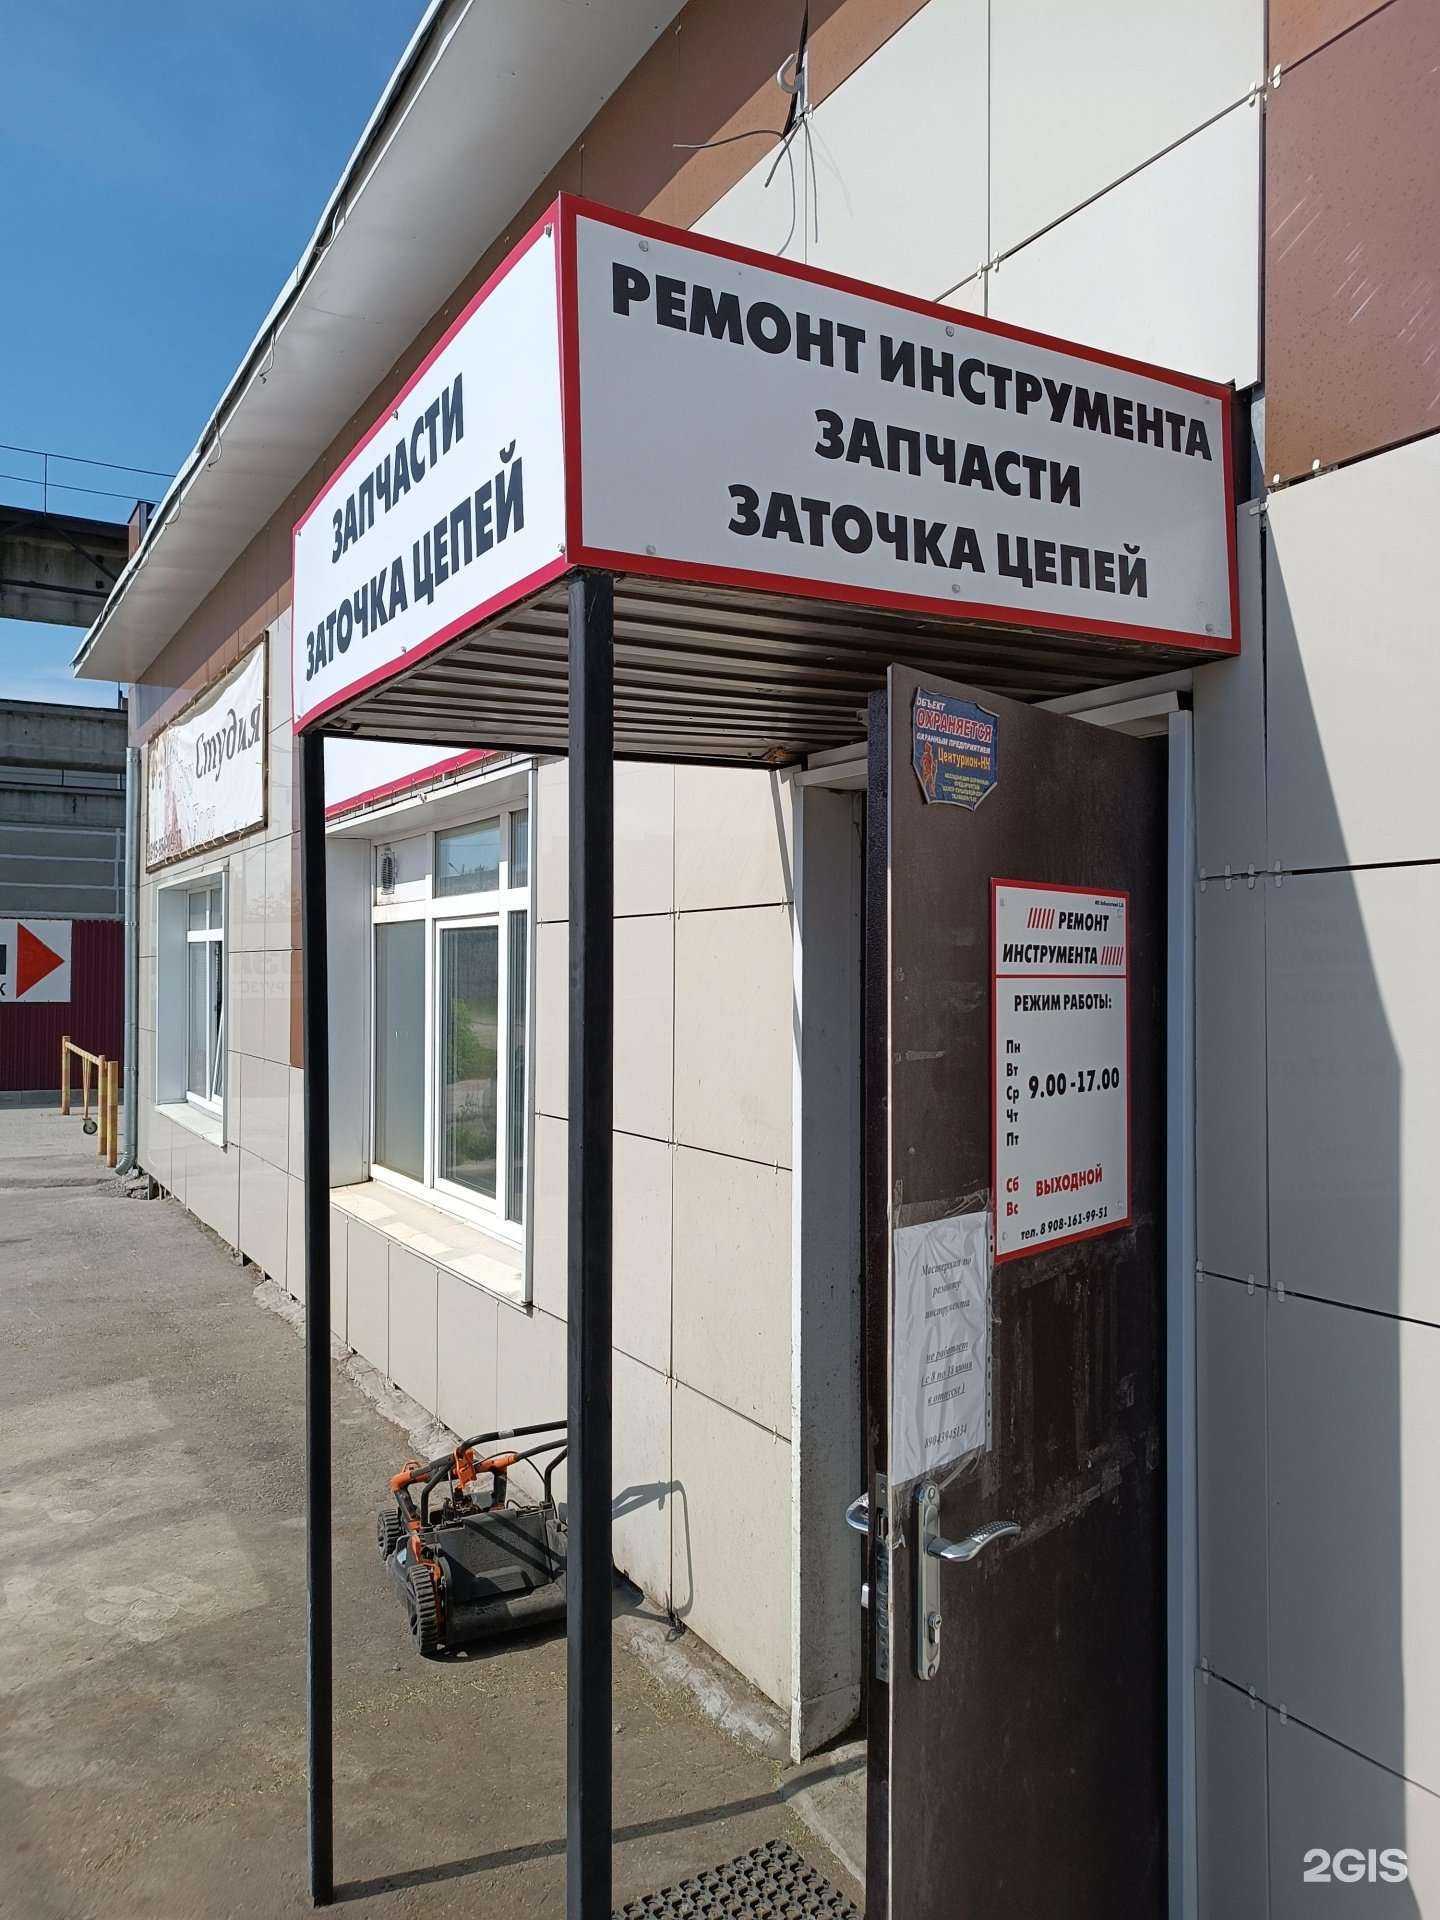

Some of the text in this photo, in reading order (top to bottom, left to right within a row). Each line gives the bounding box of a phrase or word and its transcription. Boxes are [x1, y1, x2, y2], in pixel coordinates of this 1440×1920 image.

[612, 262, 1213, 461] РЕМОНТ ИНСТРУМЕНТА
[331, 371, 465, 565] ЗАПЧАСТИ
[813, 408, 1082, 508] ЗАПЧАСТИ
[726, 483, 1148, 599] ЗАТОЧКА ЦЕПЕЙ
[306, 438, 525, 682] ЗАТОЧКА ЦЕПЕЙ
[916, 708, 993, 744] ОХРАНЯЕТСЯ
[195, 703, 262, 782] Студия
[1058, 911, 1110, 932] РЕМОНТ
[1002, 943, 1098, 965] ИНСТРУМЕНТА
[1014, 994, 1112, 1012] РЕЖИМ РАБОТЫ:
[1006, 1039, 1021, 1054] Пн
[1006, 1062, 1019, 1077] Вт
[1006, 1086, 1020, 1104] Ср
[1006, 1109, 1019, 1123] Чт
[1006, 1132, 1019, 1147] Пт
[1006, 1163, 1103, 1197] Сб ВЫХОДНОЙ
[1006, 1202, 1019, 1217] Вс
[1021, 1206, 1108, 1240] тел. 8 908-161-99-51
